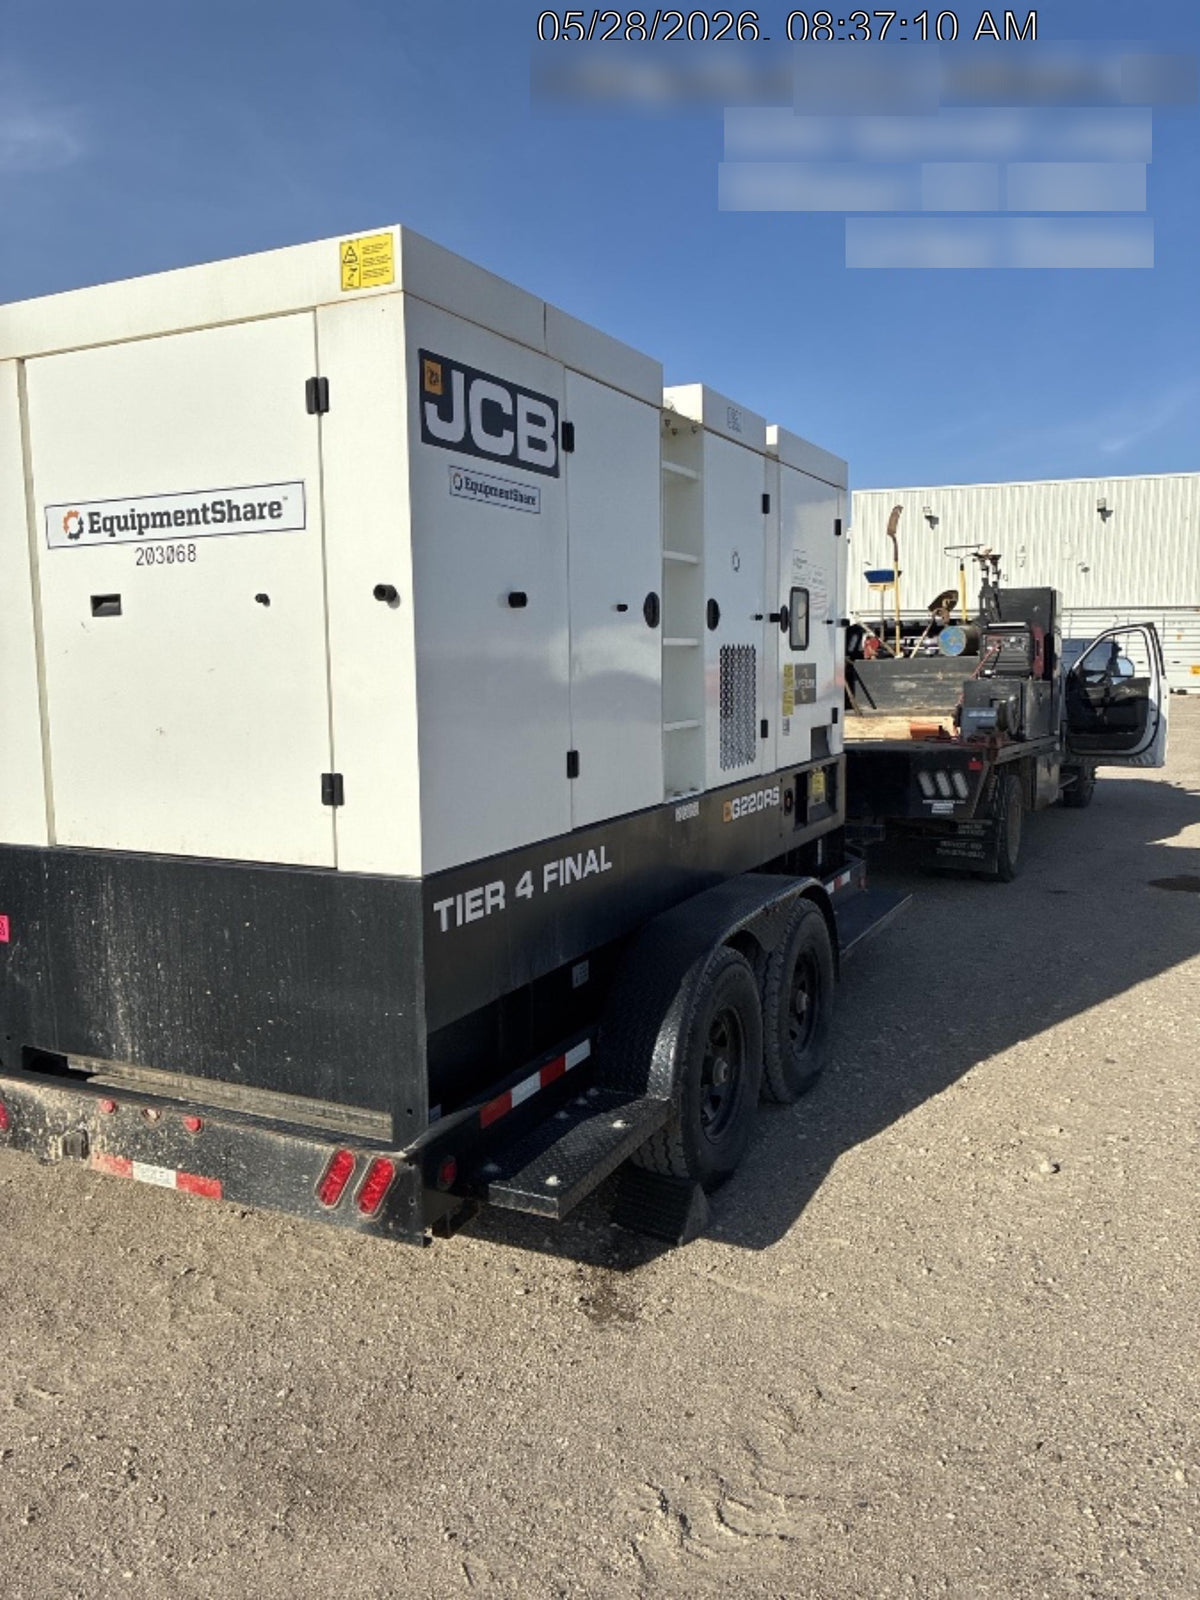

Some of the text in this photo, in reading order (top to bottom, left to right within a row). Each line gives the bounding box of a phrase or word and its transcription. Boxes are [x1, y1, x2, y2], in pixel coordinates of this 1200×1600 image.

[424, 368, 557, 469] JCB
[87, 499, 283, 538] EquipmentShare
[135, 543, 197, 566] 203068
[433, 845, 613, 932] TIER 4 FINAL
